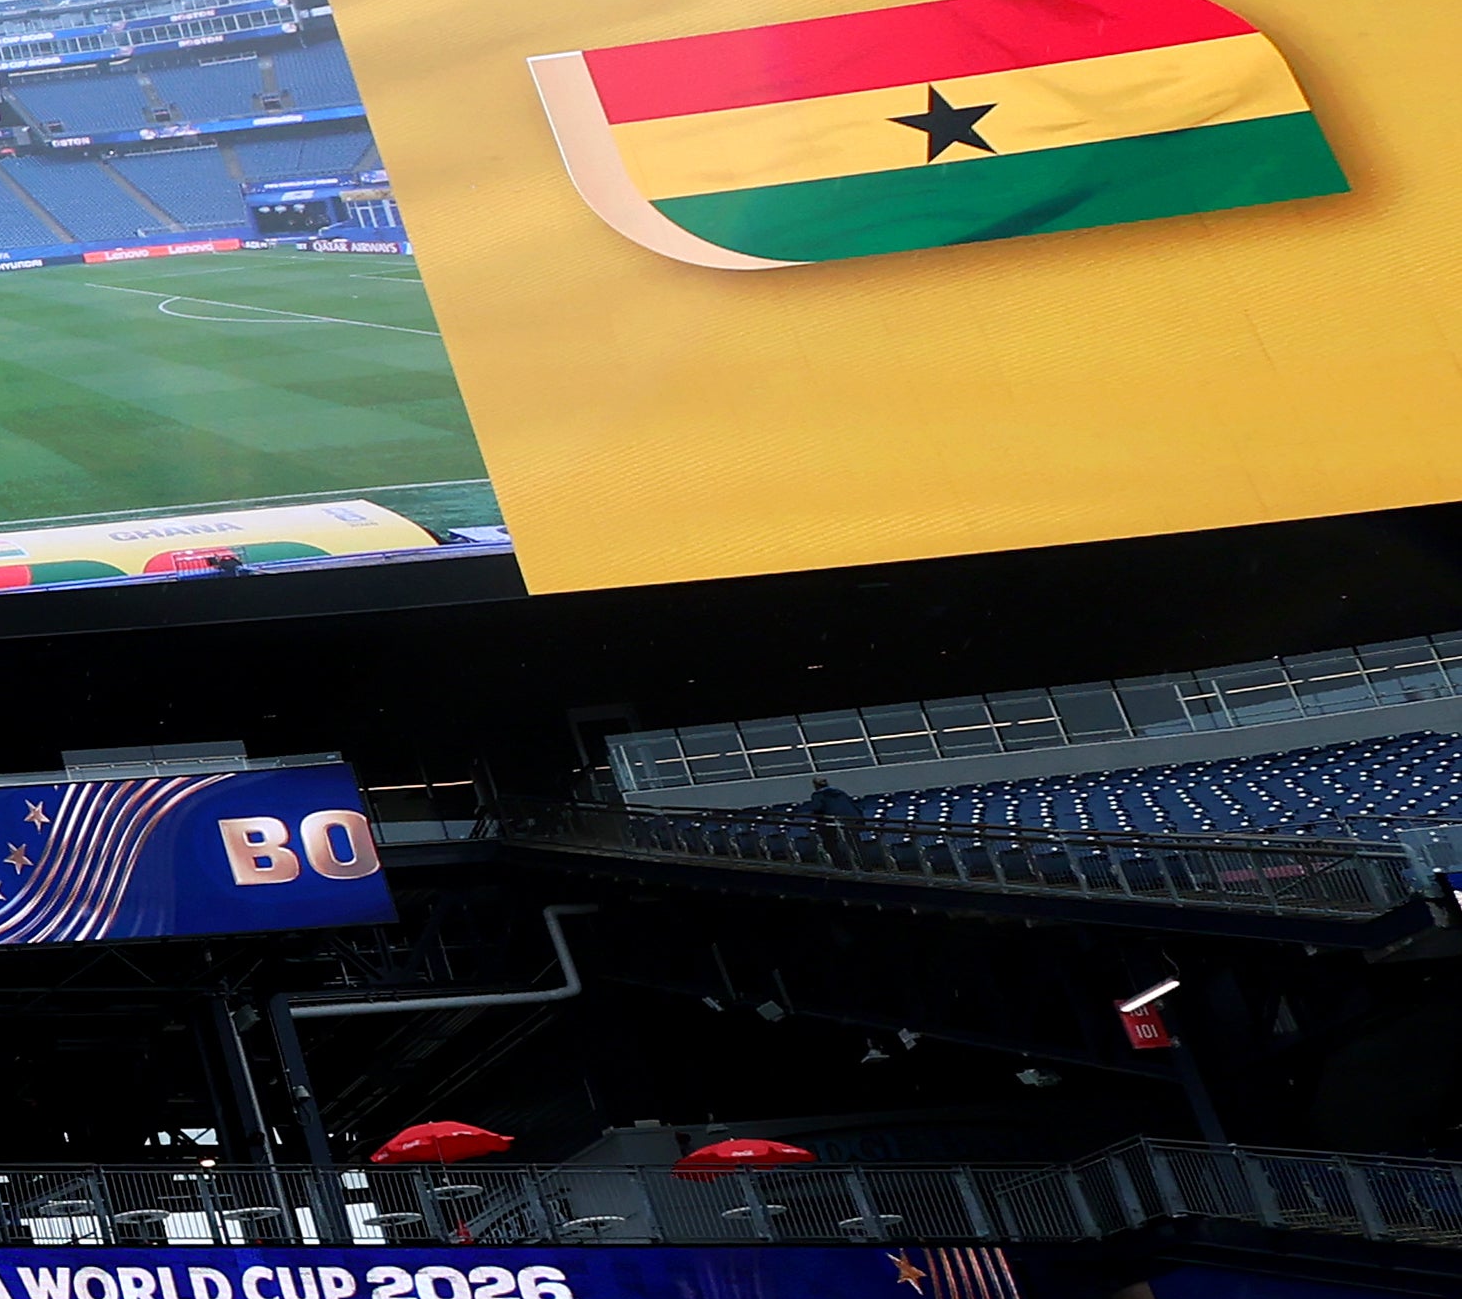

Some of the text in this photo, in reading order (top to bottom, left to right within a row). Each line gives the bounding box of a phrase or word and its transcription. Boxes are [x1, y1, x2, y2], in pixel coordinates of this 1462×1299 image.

[168, 243, 213, 254] Lenovo
[313, 241, 397, 253] QATAR AIRWAYS
[106, 248, 149, 260] Lenovo
[108, 521, 243, 541] GHANA
[218, 809, 380, 885] BO
[1135, 1024, 1158, 1039] 101
